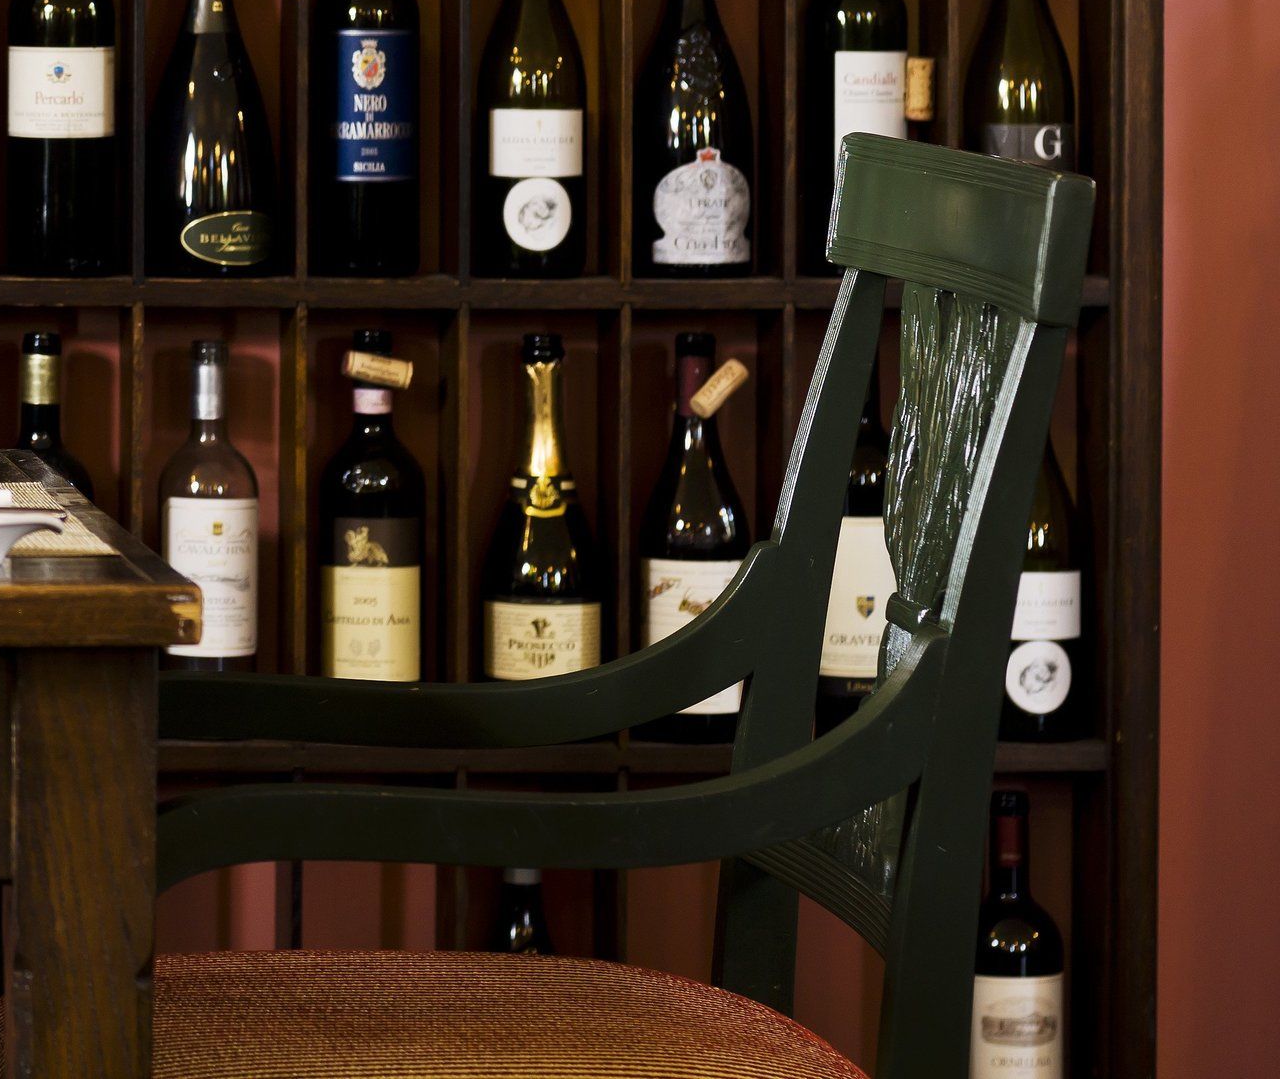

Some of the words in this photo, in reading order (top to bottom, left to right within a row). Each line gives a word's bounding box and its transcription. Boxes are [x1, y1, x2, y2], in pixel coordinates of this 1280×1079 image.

[34, 90, 85, 106] Percarlo
[354, 94, 388, 113] NERO
[1033, 125, 1062, 161] G
[353, 161, 386, 172] SICILIA
[385, 612, 412, 626] AMA
[507, 639, 577, 652] PROSECCO
